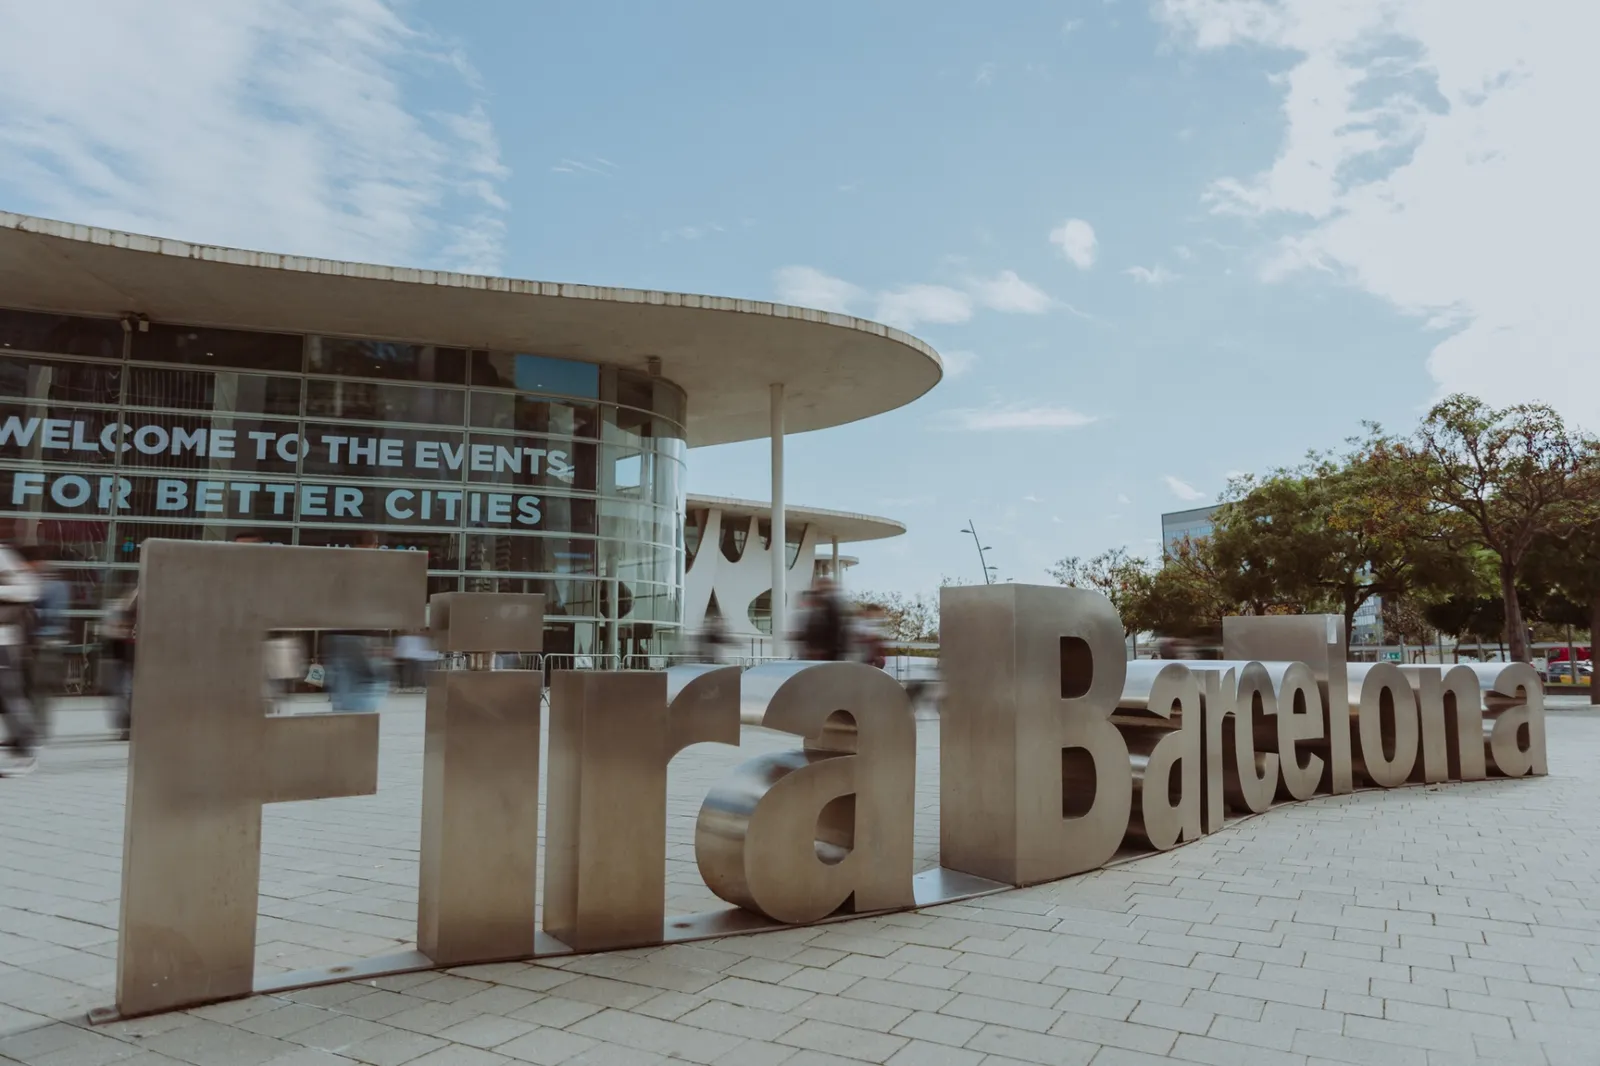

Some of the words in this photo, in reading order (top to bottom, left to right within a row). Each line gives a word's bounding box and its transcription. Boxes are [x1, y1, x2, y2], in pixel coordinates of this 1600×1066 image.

[0, 415, 237, 459] WELCOME
[248, 430, 310, 463] TO
[321, 435, 404, 467] THE
[415, 440, 574, 483] EVENTS
[12, 472, 133, 509] FOR
[156, 479, 363, 518] BETTER
[385, 488, 541, 525] CITIES
[116, 539, 917, 1017] Fira
[940, 583, 1548, 887] Barcelona
